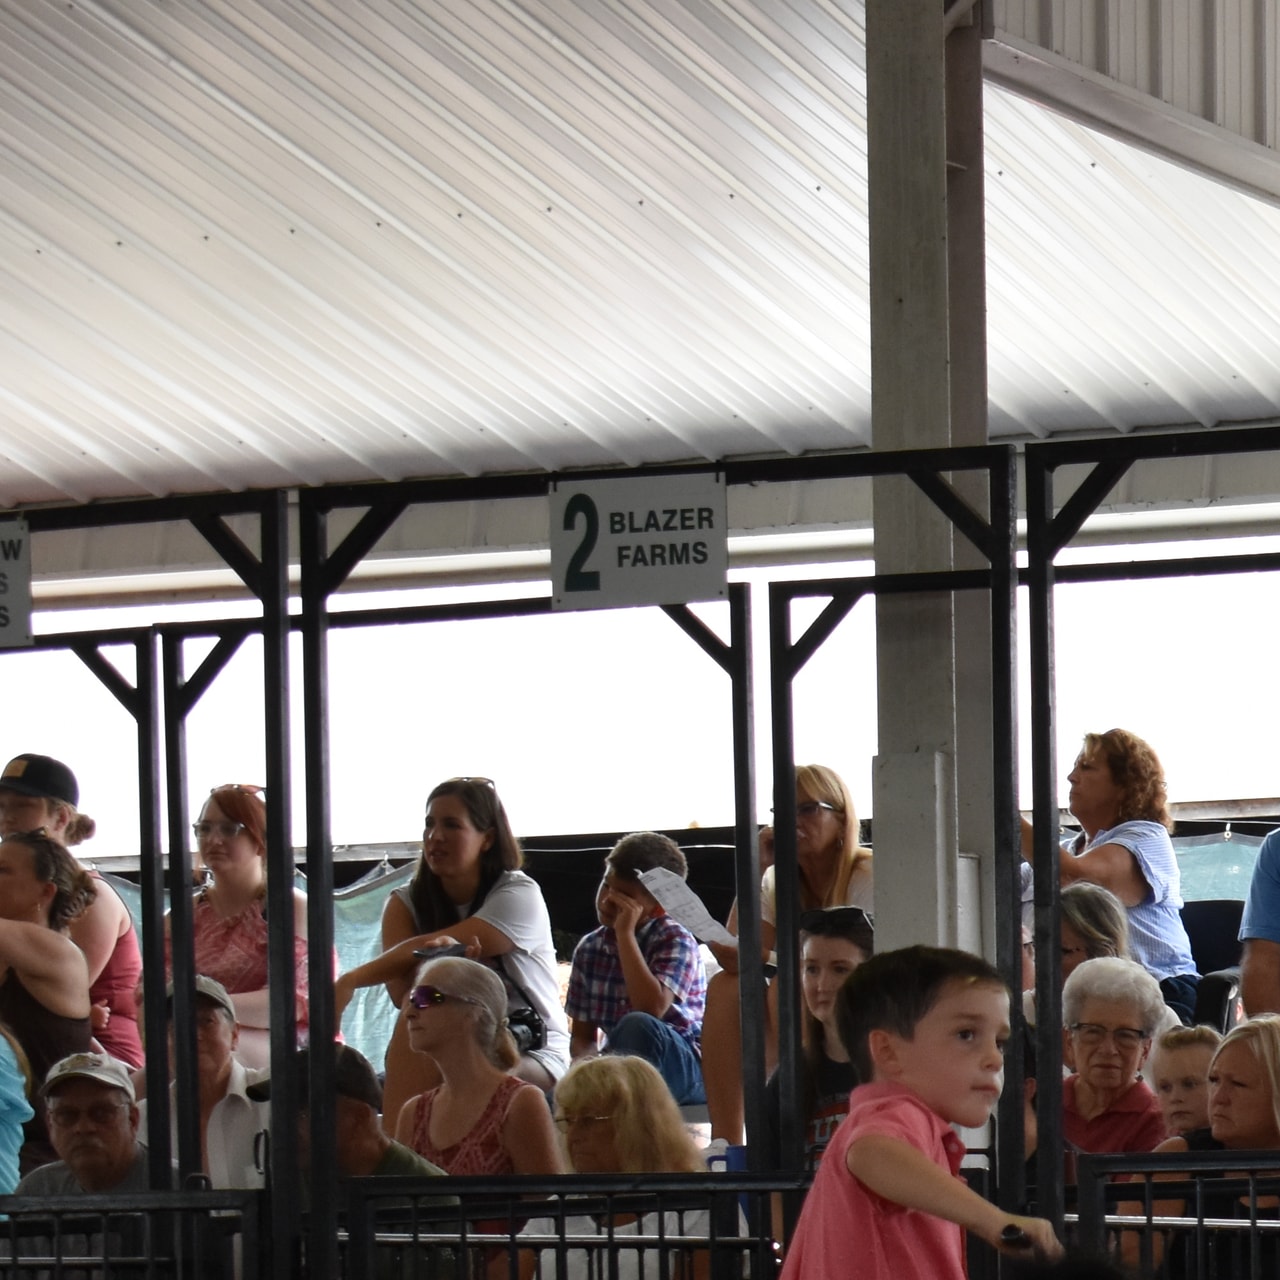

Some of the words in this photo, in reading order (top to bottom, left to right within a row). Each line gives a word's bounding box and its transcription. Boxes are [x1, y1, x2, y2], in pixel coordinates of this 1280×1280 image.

[609, 507, 715, 535] BLAZER
[563, 493, 600, 593] 2
[617, 541, 709, 568] FARMS
